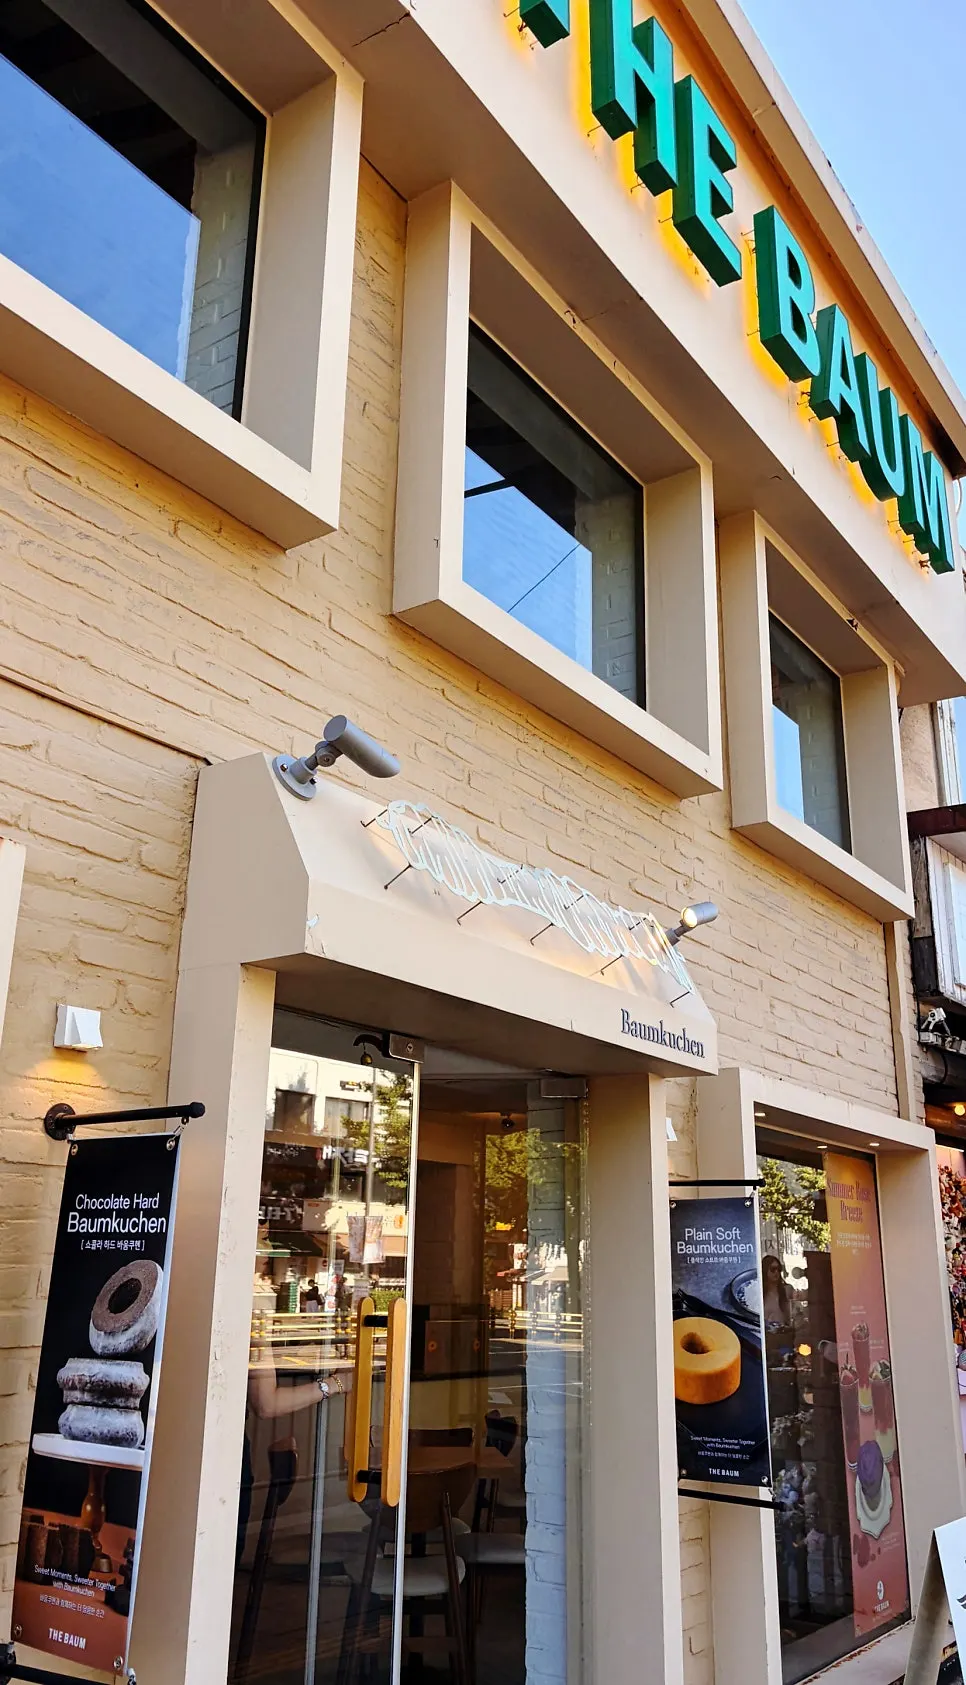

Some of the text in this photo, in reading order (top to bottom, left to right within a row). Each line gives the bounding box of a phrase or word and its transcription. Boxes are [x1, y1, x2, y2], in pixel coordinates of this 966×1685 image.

[520, 0, 955, 574] HE BAUM
[620, 1008, 705, 1058] Baumkuchen
[75, 1192, 160, 1210] Chocolate Hard
[67, 1211, 166, 1233] Baumkuchen
[684, 1227, 741, 1241] Plain Soft
[104, 1239, 116, 1250] 하드
[676, 1241, 754, 1254] Baumkuchen
[708, 1467, 740, 1477] THE BAUM
[34, 1564, 50, 1576] Sweet
[95, 1579, 116, 1592] Together
[63, 1582, 95, 1597] Baumkuchen
[48, 1627, 86, 1650] THE BAUM
